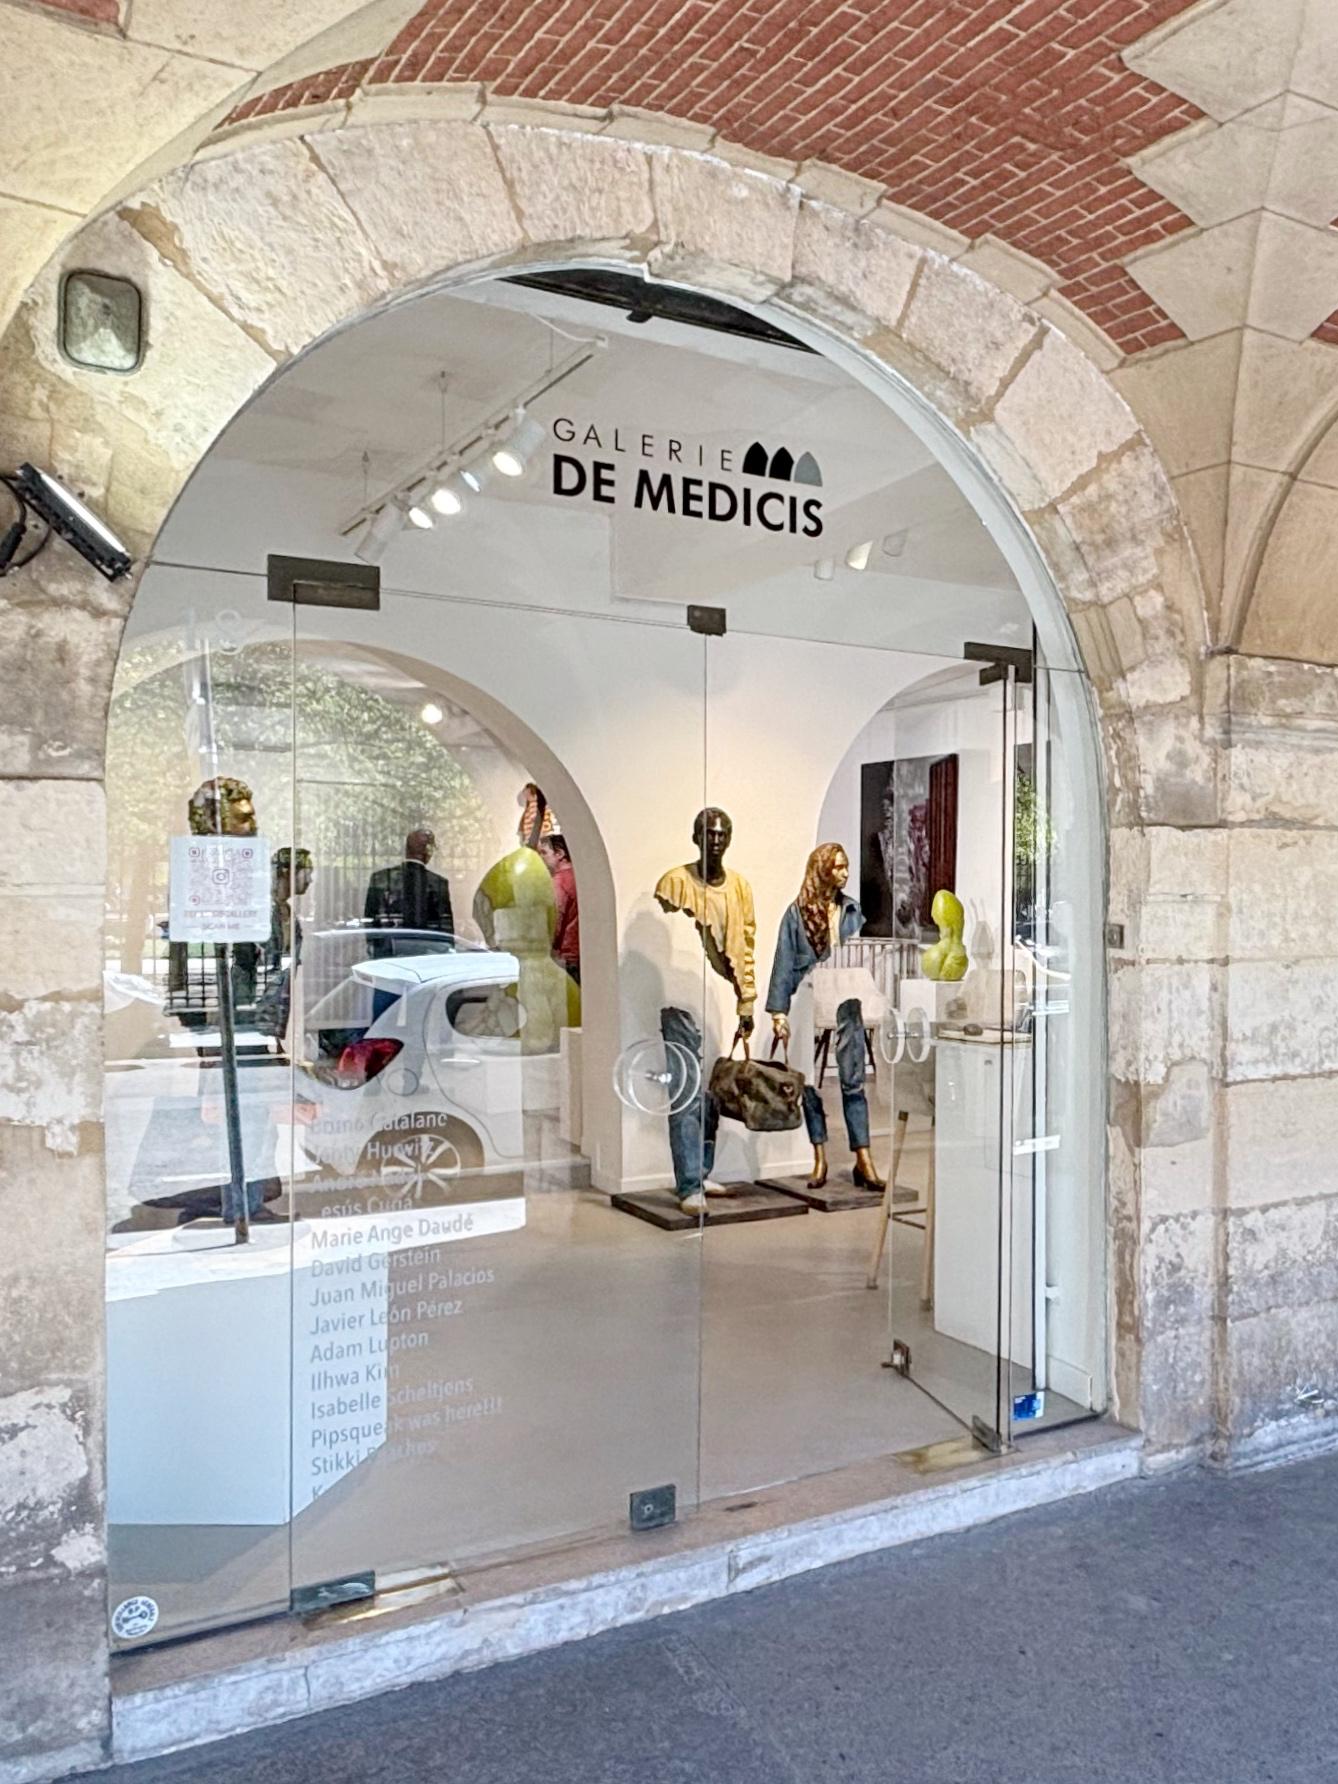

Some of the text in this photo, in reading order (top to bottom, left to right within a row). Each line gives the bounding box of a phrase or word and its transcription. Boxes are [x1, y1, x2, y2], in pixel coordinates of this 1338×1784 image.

[552, 418, 733, 472] GALERIE
[553, 453, 823, 537] DE MEDICIS
[367, 1138, 435, 1160] Huwiz
[320, 1198, 362, 1220] esús
[311, 1213, 474, 1249] Marie Ange Daudé
[311, 1247, 440, 1278] David Gerstein
[309, 1267, 495, 1307] Juan Miguel Palacios
[309, 1298, 464, 1335] Javier León Pérez
[310, 1331, 429, 1363] Adam Lupton
[311, 1371, 359, 1391] Ilhwa
[311, 1391, 381, 1419] Isabelle
[311, 1449, 361, 1476] Stikki
